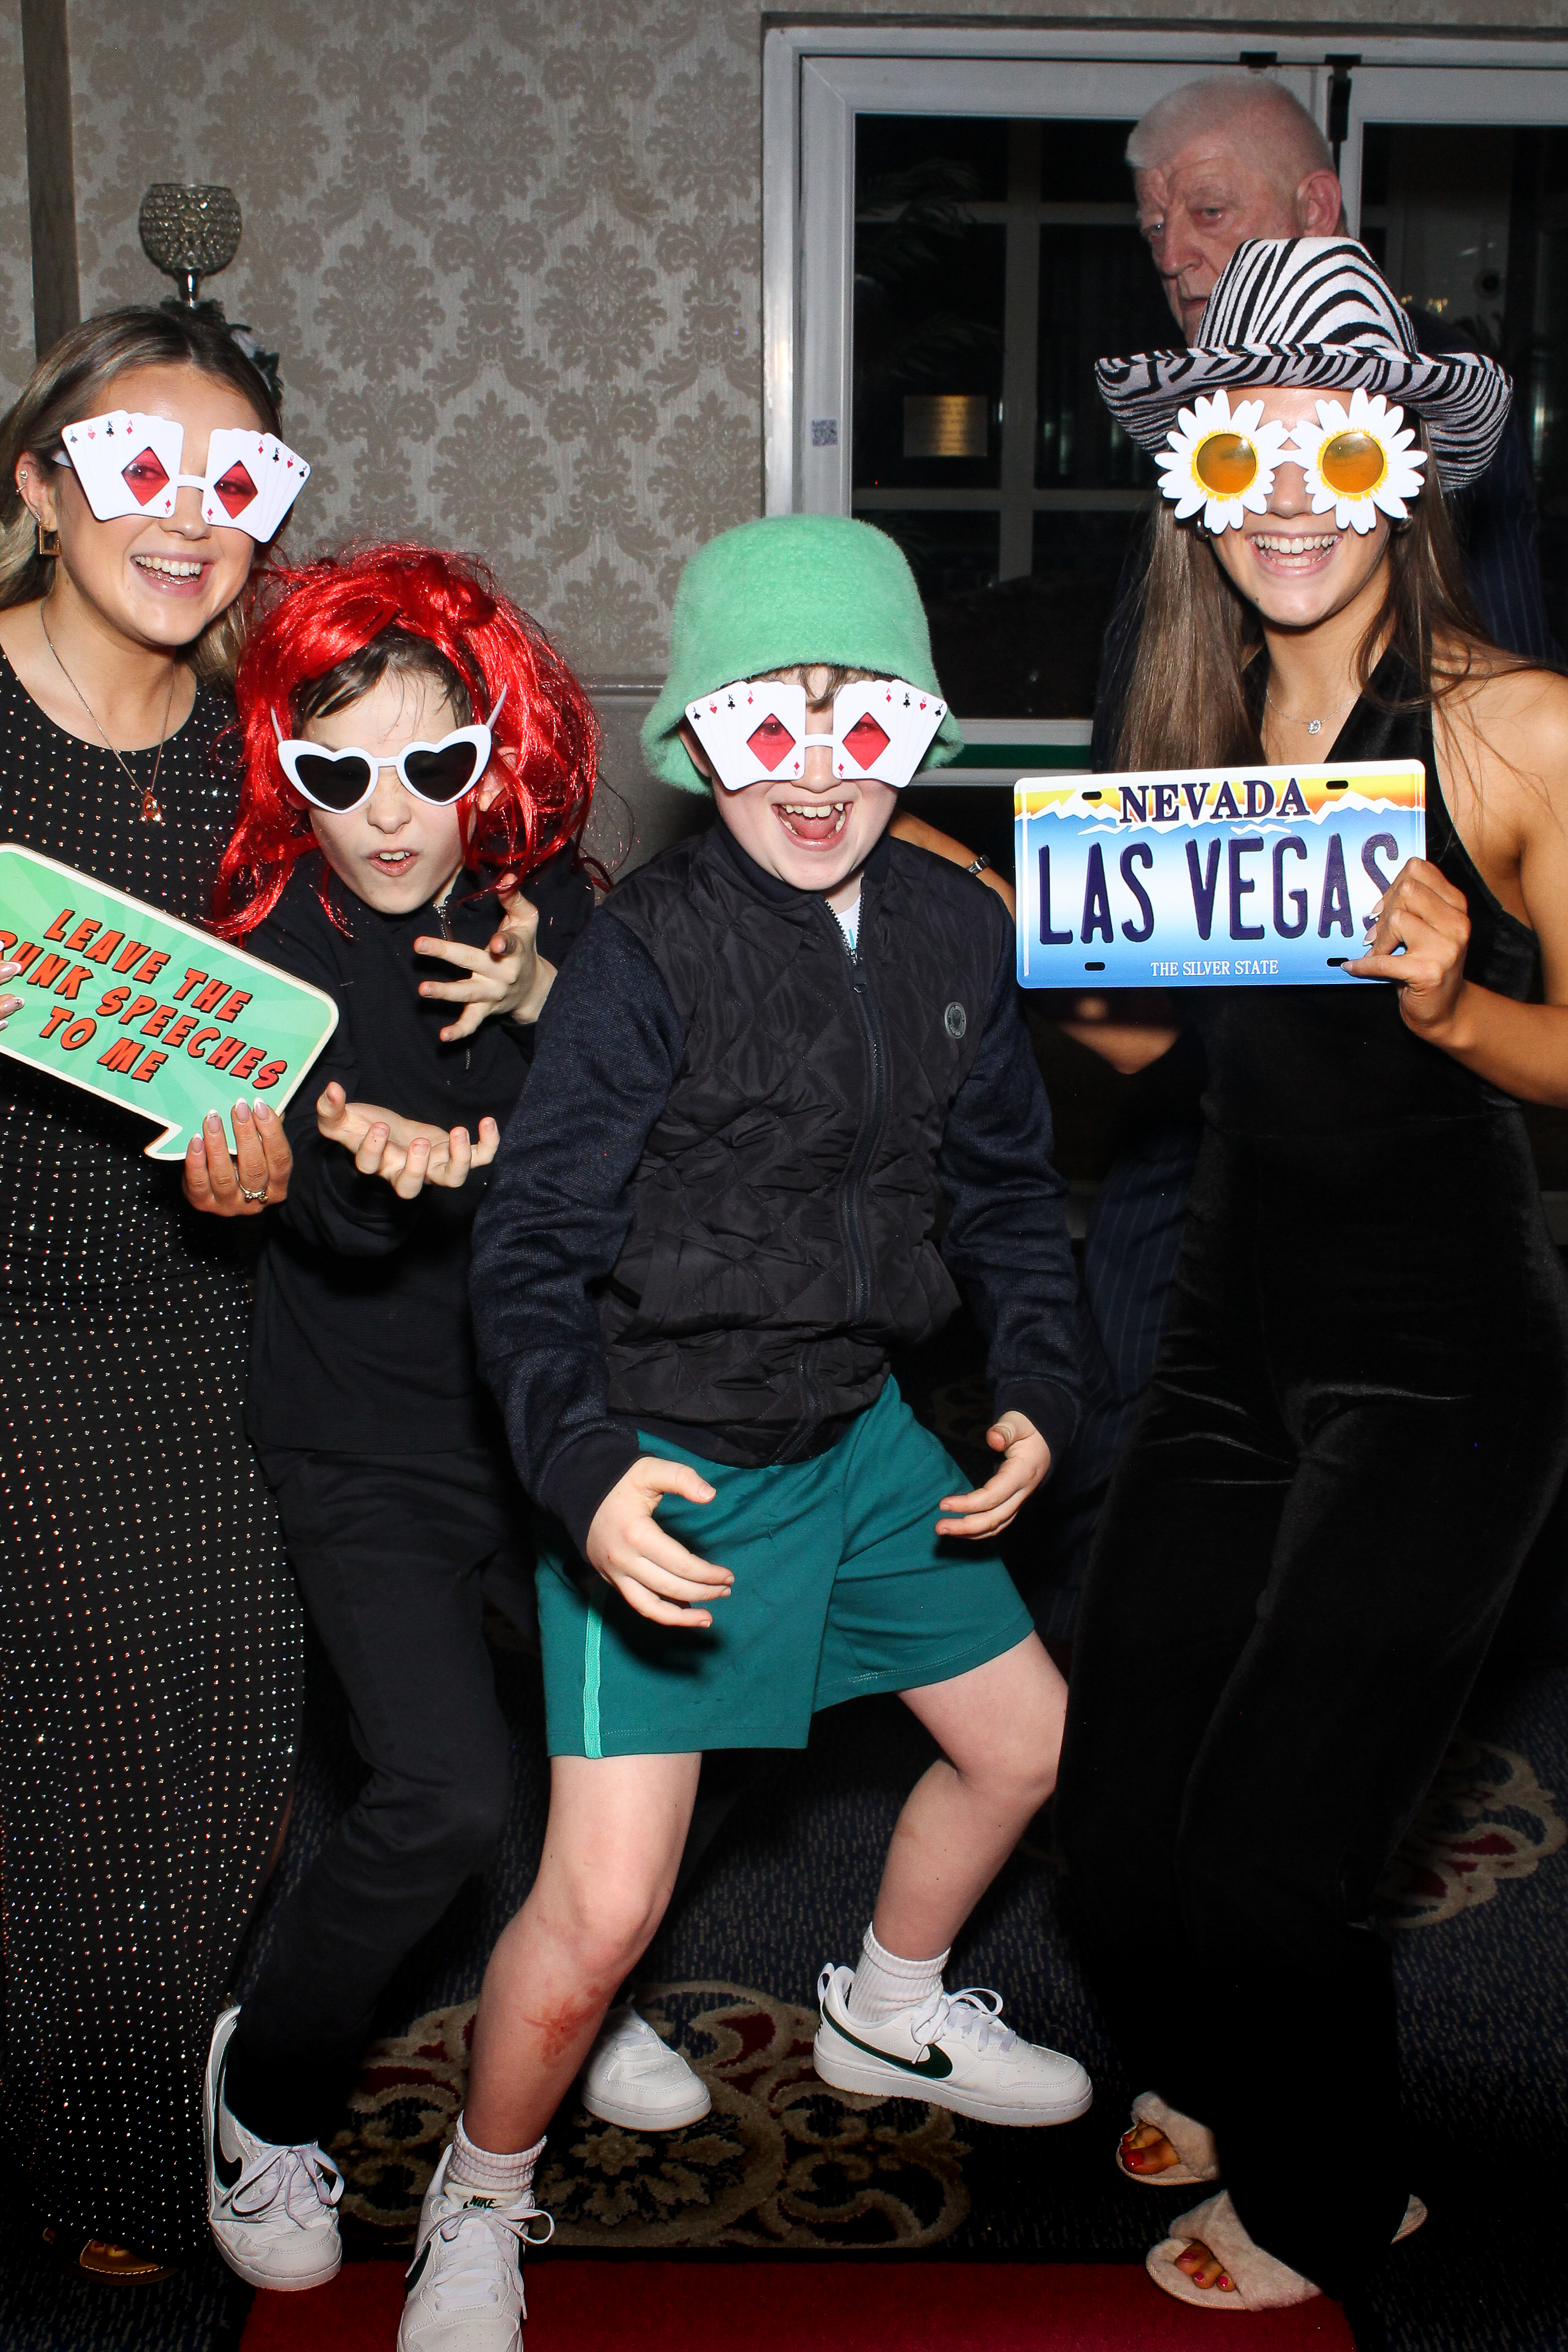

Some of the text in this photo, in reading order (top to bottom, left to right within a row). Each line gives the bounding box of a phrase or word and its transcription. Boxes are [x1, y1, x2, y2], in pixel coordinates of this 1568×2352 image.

[1118, 777, 1310, 824] NEVADA
[1038, 832, 1398, 945] LAS VEGAS
[43, 909, 254, 1023] LEAVE THE
[1150, 960, 1279, 977] THE SILVER STATE
[40, 1006, 169, 1084] TO ME
[96, 987, 288, 1090] SPEECHES
[469, 2195, 498, 2209] NIKE
